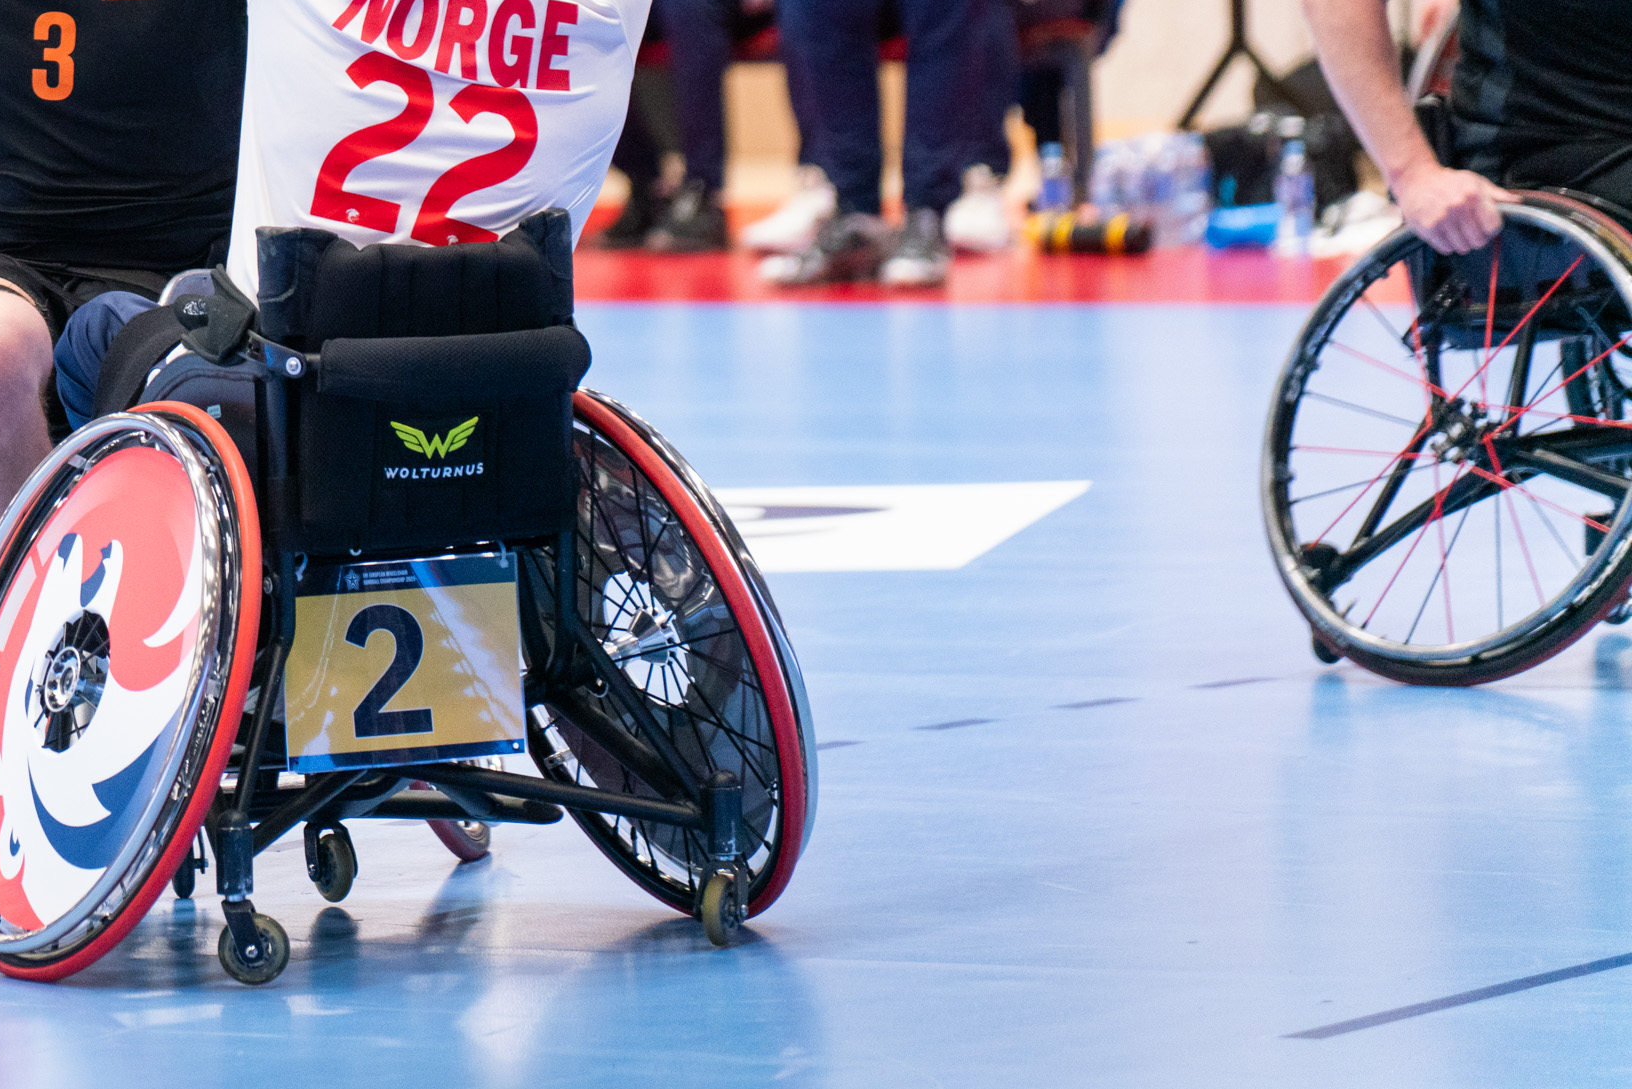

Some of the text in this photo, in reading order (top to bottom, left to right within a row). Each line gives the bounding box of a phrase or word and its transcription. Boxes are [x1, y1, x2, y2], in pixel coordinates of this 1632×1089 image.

[31, 11, 77, 102] 3
[310, 50, 538, 247] 22
[384, 462, 485, 480] WOLTURNUS
[344, 602, 435, 739] 2
